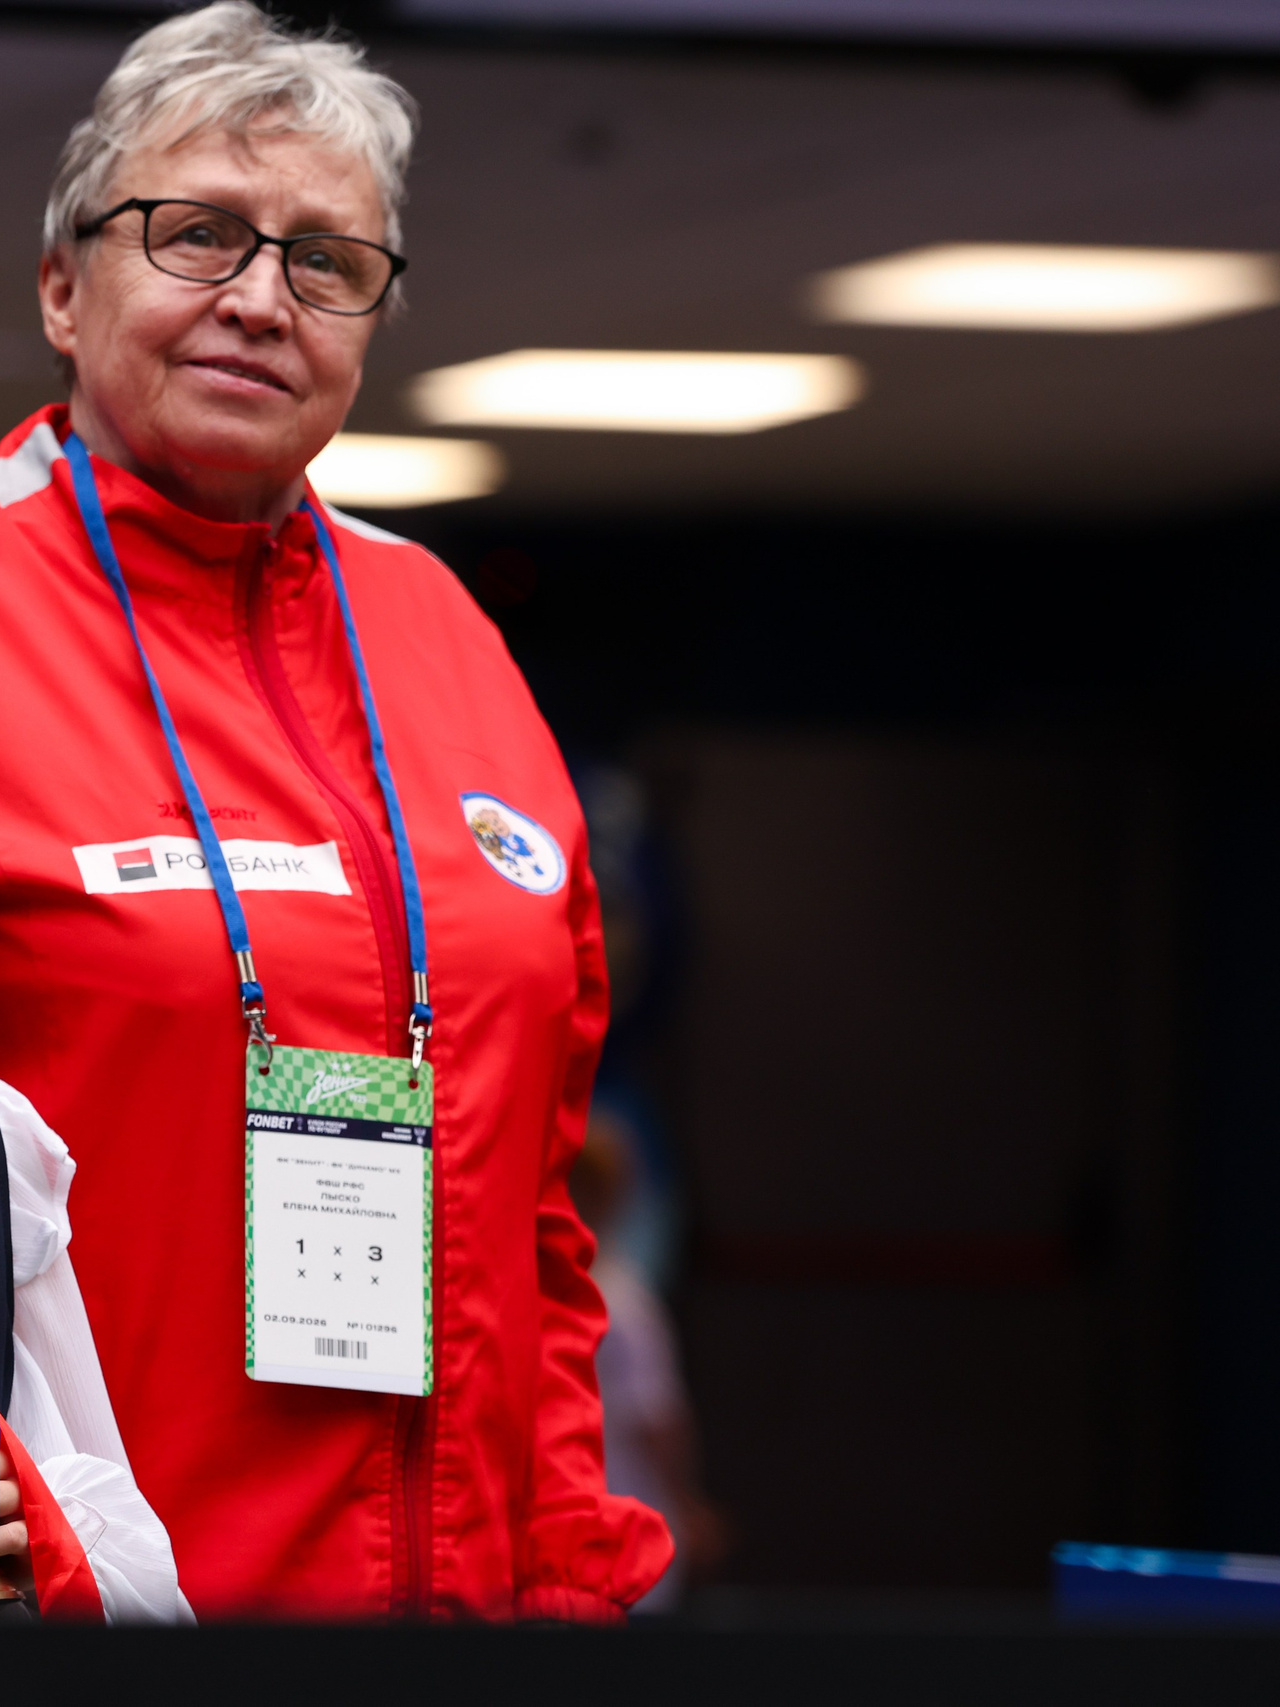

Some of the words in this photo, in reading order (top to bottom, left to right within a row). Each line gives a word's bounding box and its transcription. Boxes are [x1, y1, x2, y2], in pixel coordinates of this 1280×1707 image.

[165, 852, 310, 874] РОБАНК
[247, 1113, 295, 1130] FONBET
[342, 1181, 365, 1191] РФС
[320, 1192, 360, 1204] ЛЫСКО
[283, 1202, 318, 1212] ЕЛЕНА
[320, 1205, 397, 1219] МИХАЙЛОВНА
[296, 1239, 304, 1254] 1
[368, 1246, 383, 1262] 3
